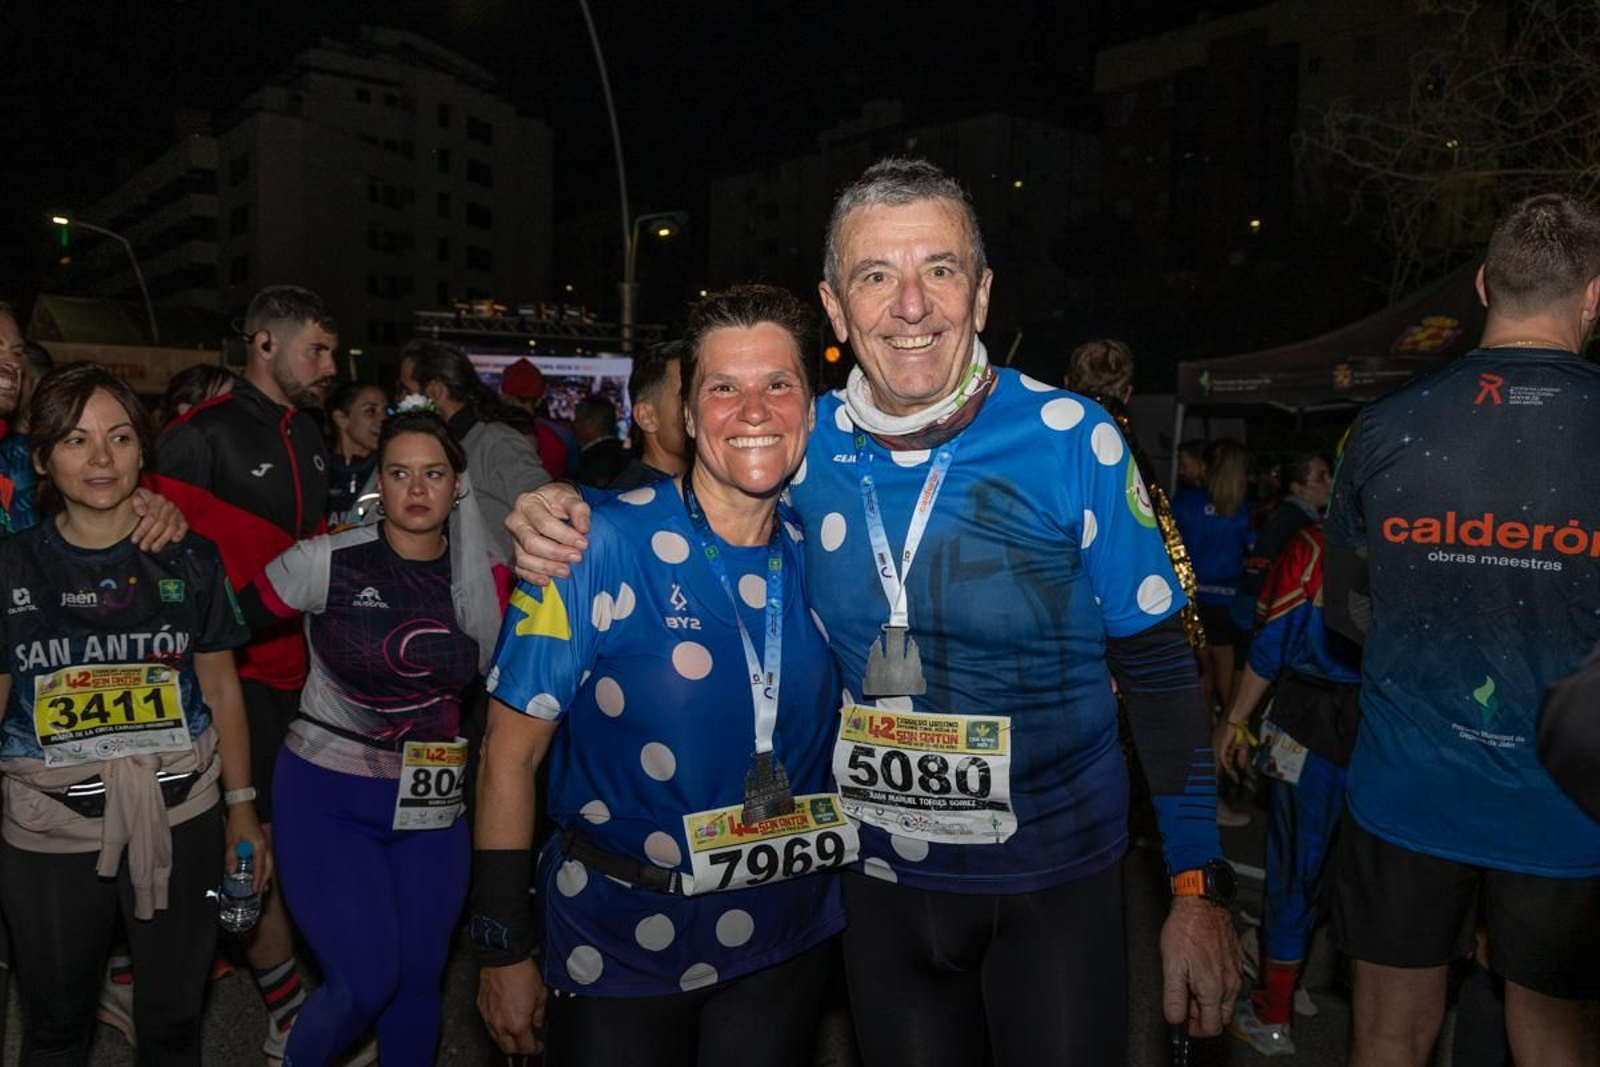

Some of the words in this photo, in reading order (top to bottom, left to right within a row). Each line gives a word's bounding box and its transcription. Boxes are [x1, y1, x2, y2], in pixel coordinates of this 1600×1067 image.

[1427, 551, 1476, 565] obras
[1481, 555, 1563, 571] maestras
[665, 617, 702, 630] BY2
[15, 637, 71, 673] SAN
[82, 624, 189, 663] ANTÓN
[65, 670, 93, 689] 42
[48, 687, 166, 731] 3411
[868, 715, 897, 742] 42
[425, 747, 446, 762] 42
[848, 745, 992, 799] 5080
[709, 831, 845, 890] 7969
